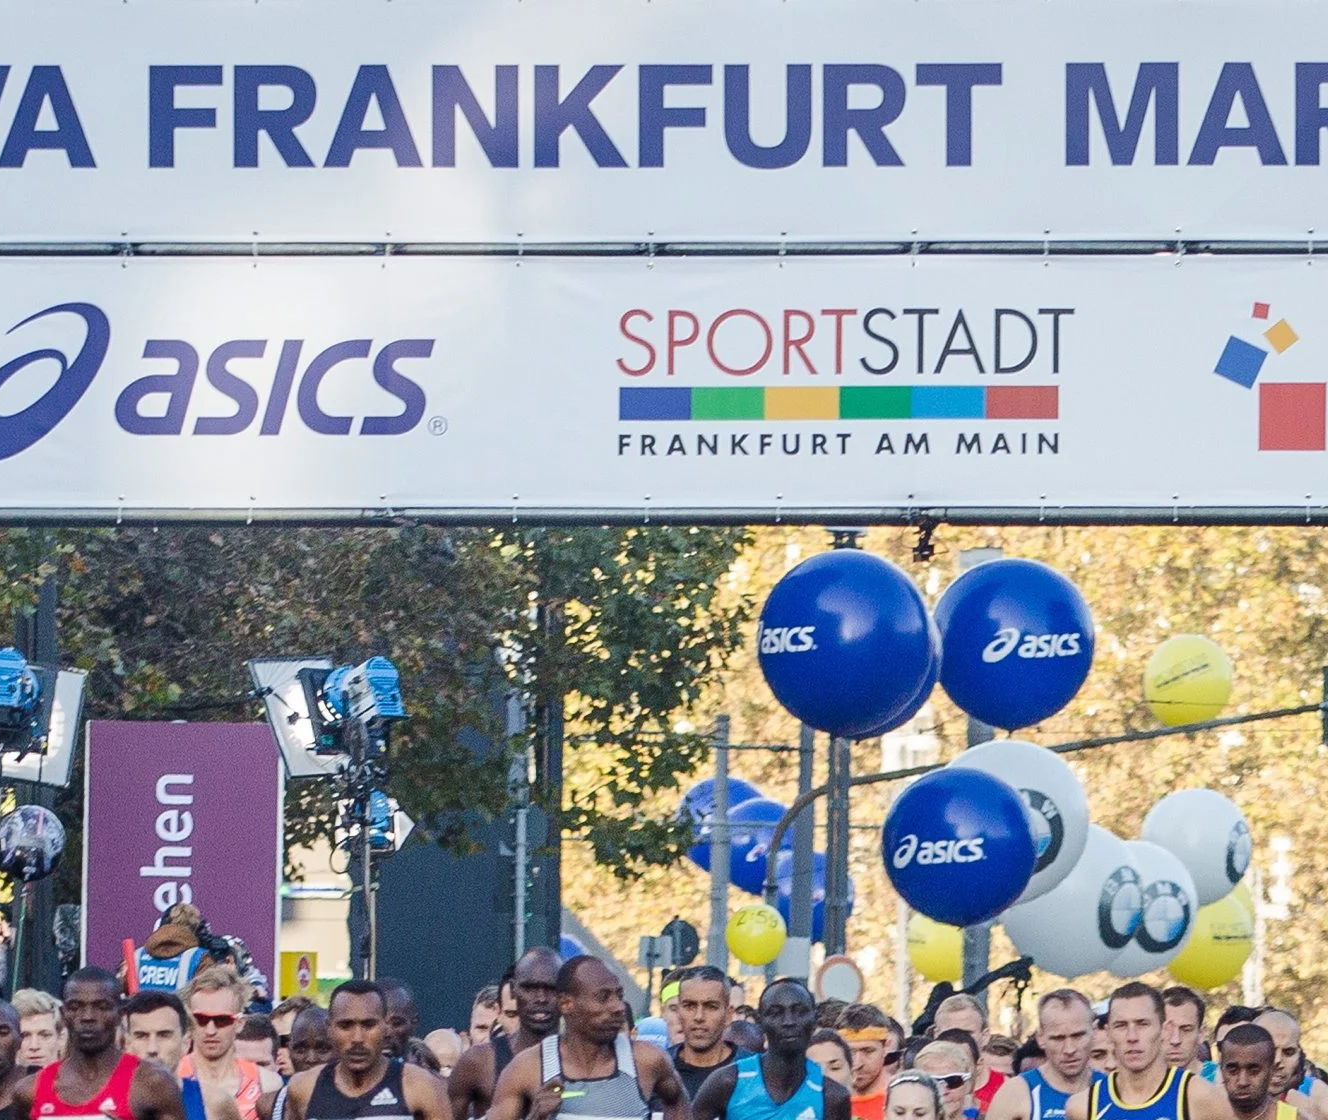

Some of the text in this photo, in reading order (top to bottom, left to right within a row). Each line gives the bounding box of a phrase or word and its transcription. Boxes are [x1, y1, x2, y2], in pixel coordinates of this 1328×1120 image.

[147, 62, 1003, 170] FRANKFURT
[615, 307, 1075, 377] SPORTSTADT
[618, 431, 1061, 457] FRANKFURT AM MAIN
[139, 773, 195, 916] ehen
[139, 965, 179, 986] CREW
